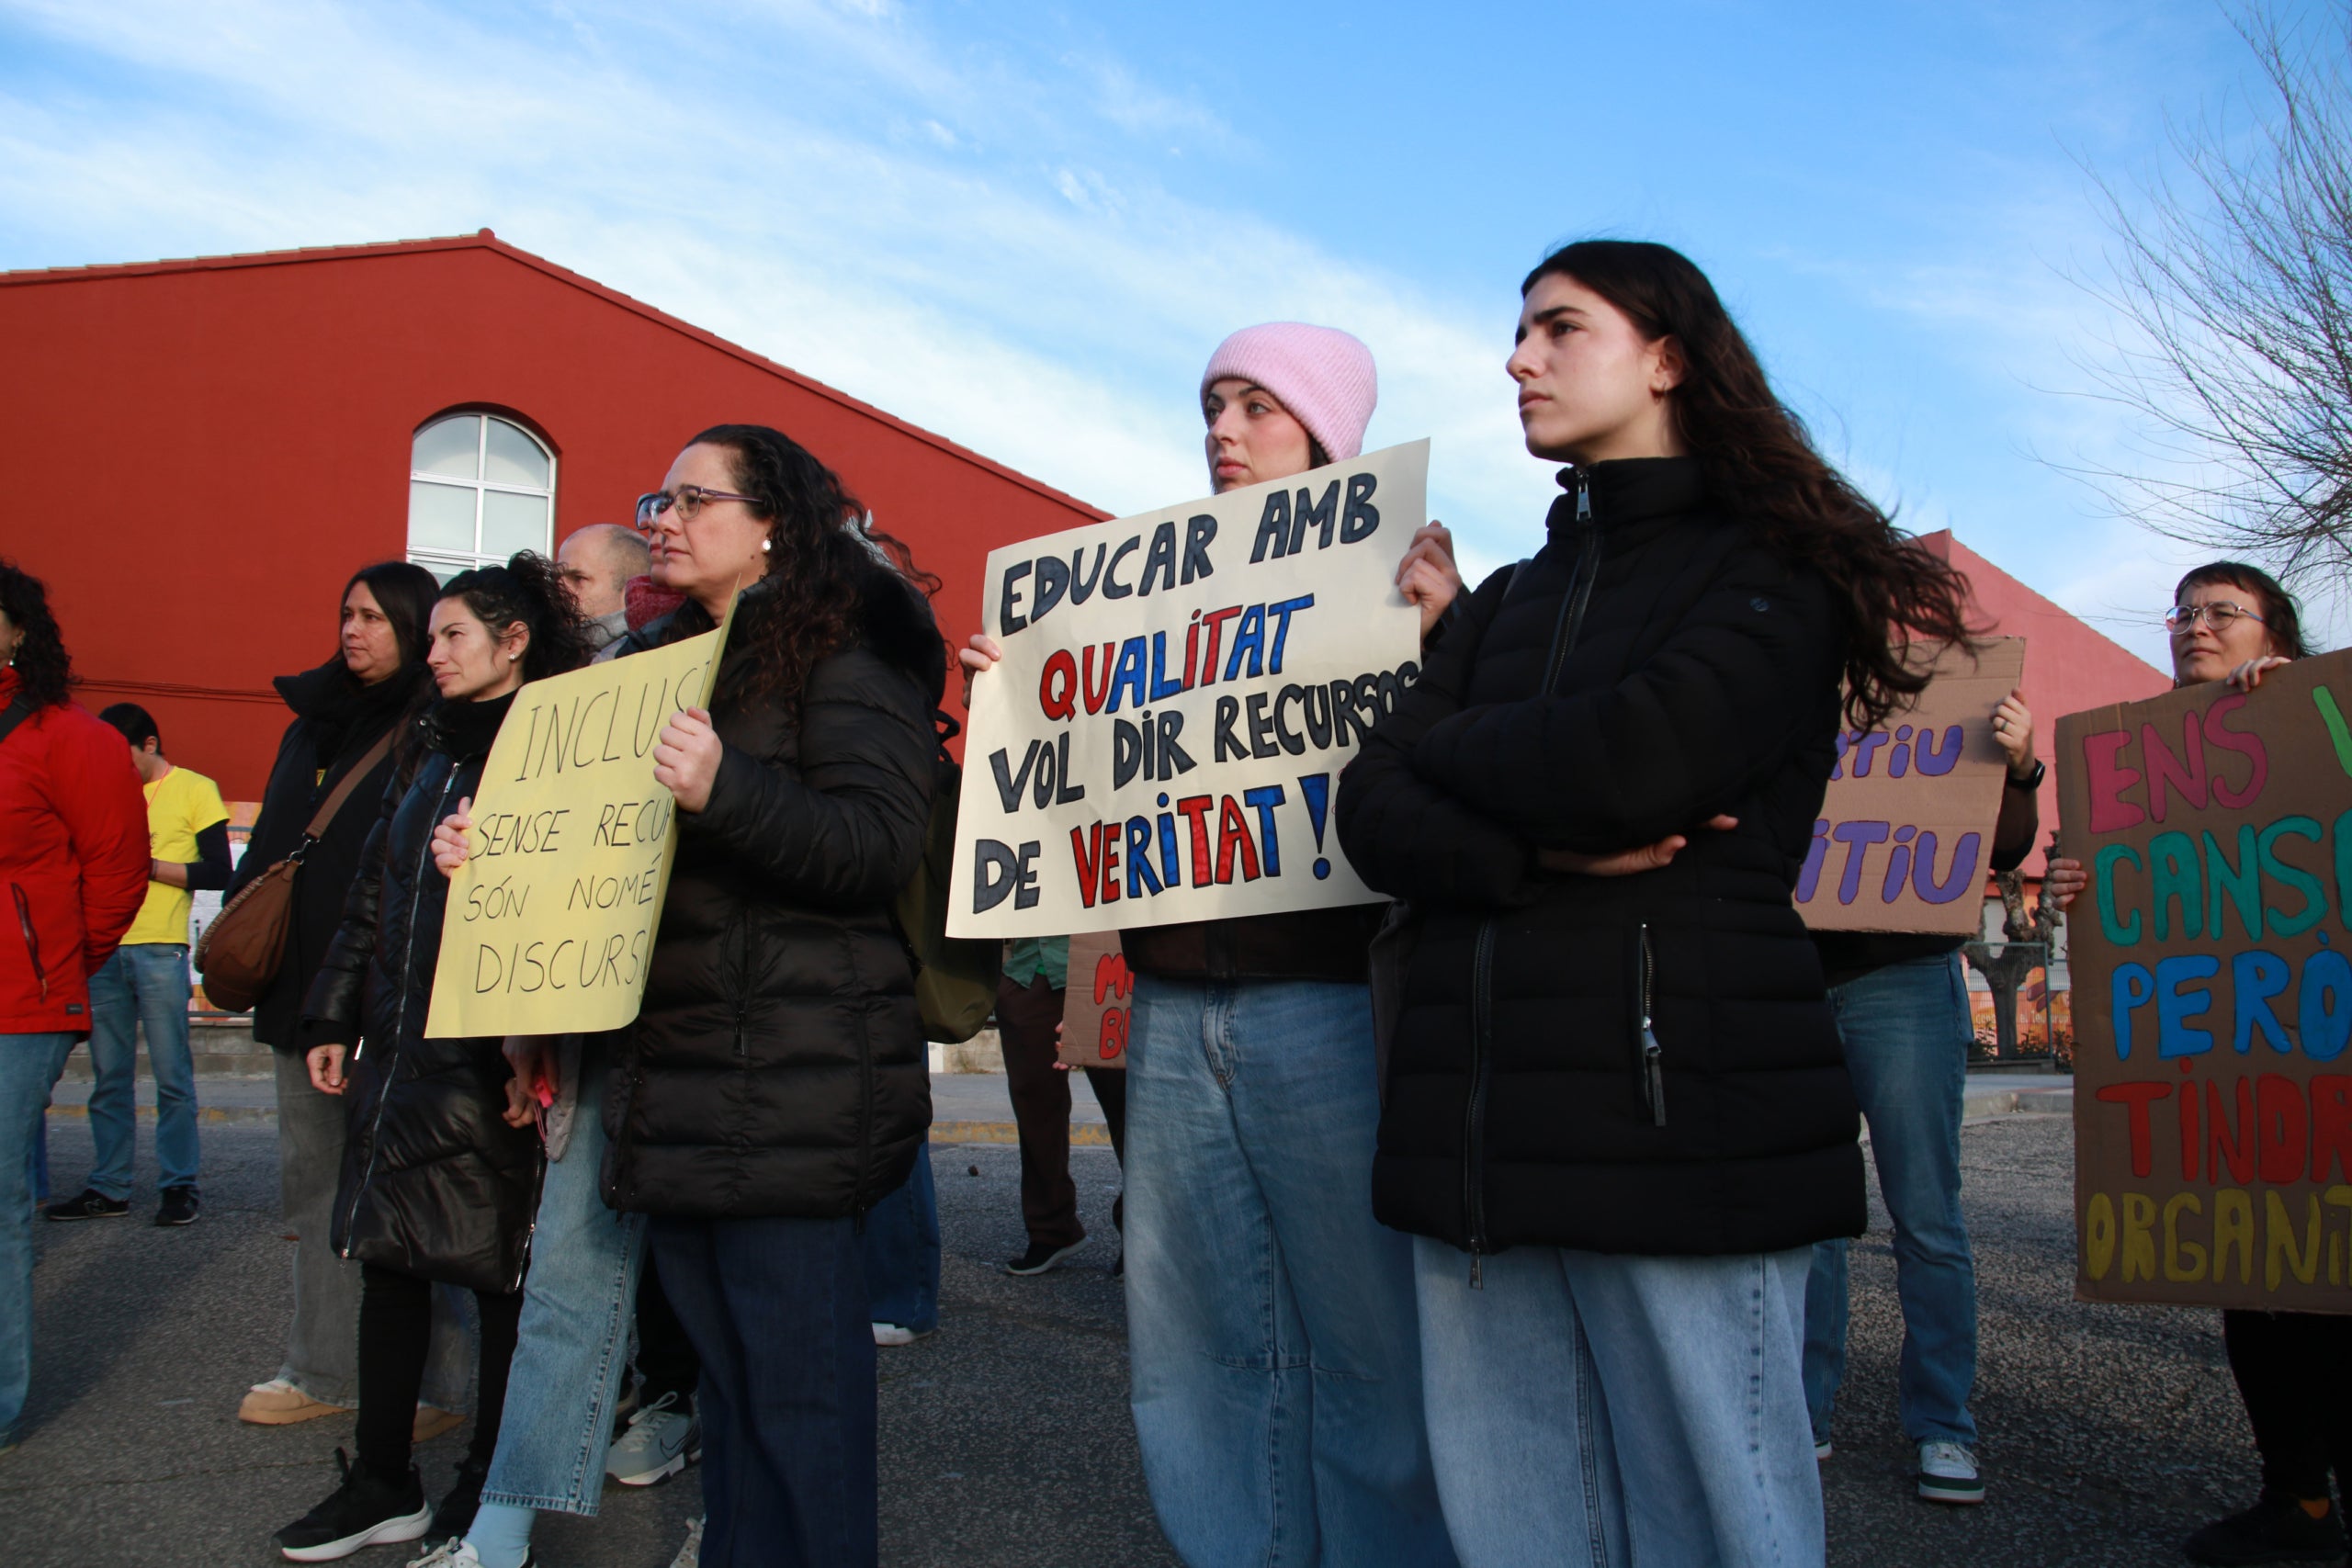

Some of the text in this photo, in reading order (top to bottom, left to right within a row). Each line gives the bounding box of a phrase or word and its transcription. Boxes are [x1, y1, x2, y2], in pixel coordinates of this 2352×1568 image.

[1000, 472, 1381, 637] EDUCAR AMB
[988, 731, 1086, 815] VOL
[2083, 693, 2268, 835] ENS
[469, 809, 571, 861] SENSE
[463, 852, 662, 922] SÓN NOMÉ
[971, 838, 1042, 915] DE
[2094, 810, 2352, 947] CANS
[474, 929, 648, 994] DISCURS
[1093, 953, 1136, 1005] M
[2110, 930, 2352, 1063] PERÒ
